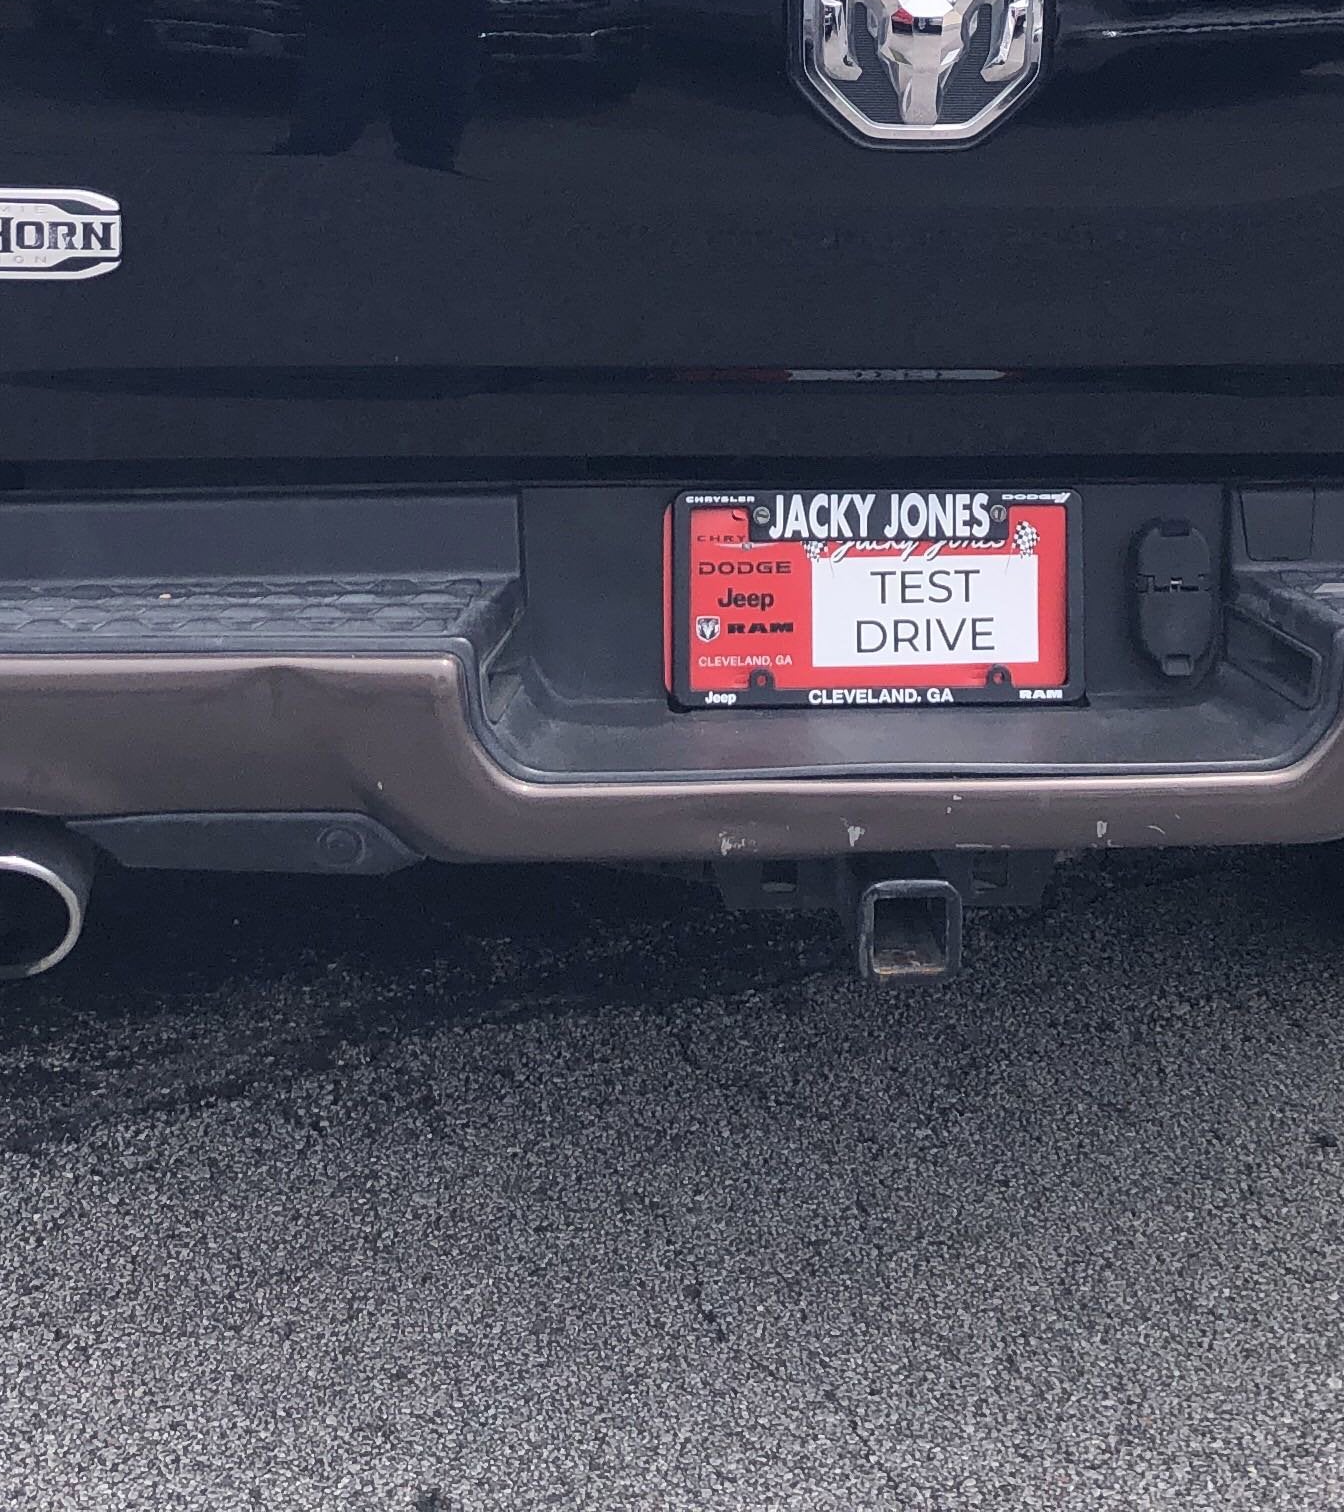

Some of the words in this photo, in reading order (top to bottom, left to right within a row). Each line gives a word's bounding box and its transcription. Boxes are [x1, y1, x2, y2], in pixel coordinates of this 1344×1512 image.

[685, 495, 756, 504] CHRYSLER
[768, 493, 877, 539] JACKY
[883, 492, 991, 538] JONES
[698, 561, 792, 575] DODGE
[870, 569, 981, 604] TEST
[718, 587, 775, 611] Jeep
[727, 622, 794, 634] RAM
[856, 617, 996, 653] DRIVE
[698, 656, 773, 668] CLEVELAND,
[775, 655, 793, 666] GA
[705, 691, 737, 705] Jeep
[926, 687, 954, 703] GA
[1018, 689, 1064, 700] RAM
